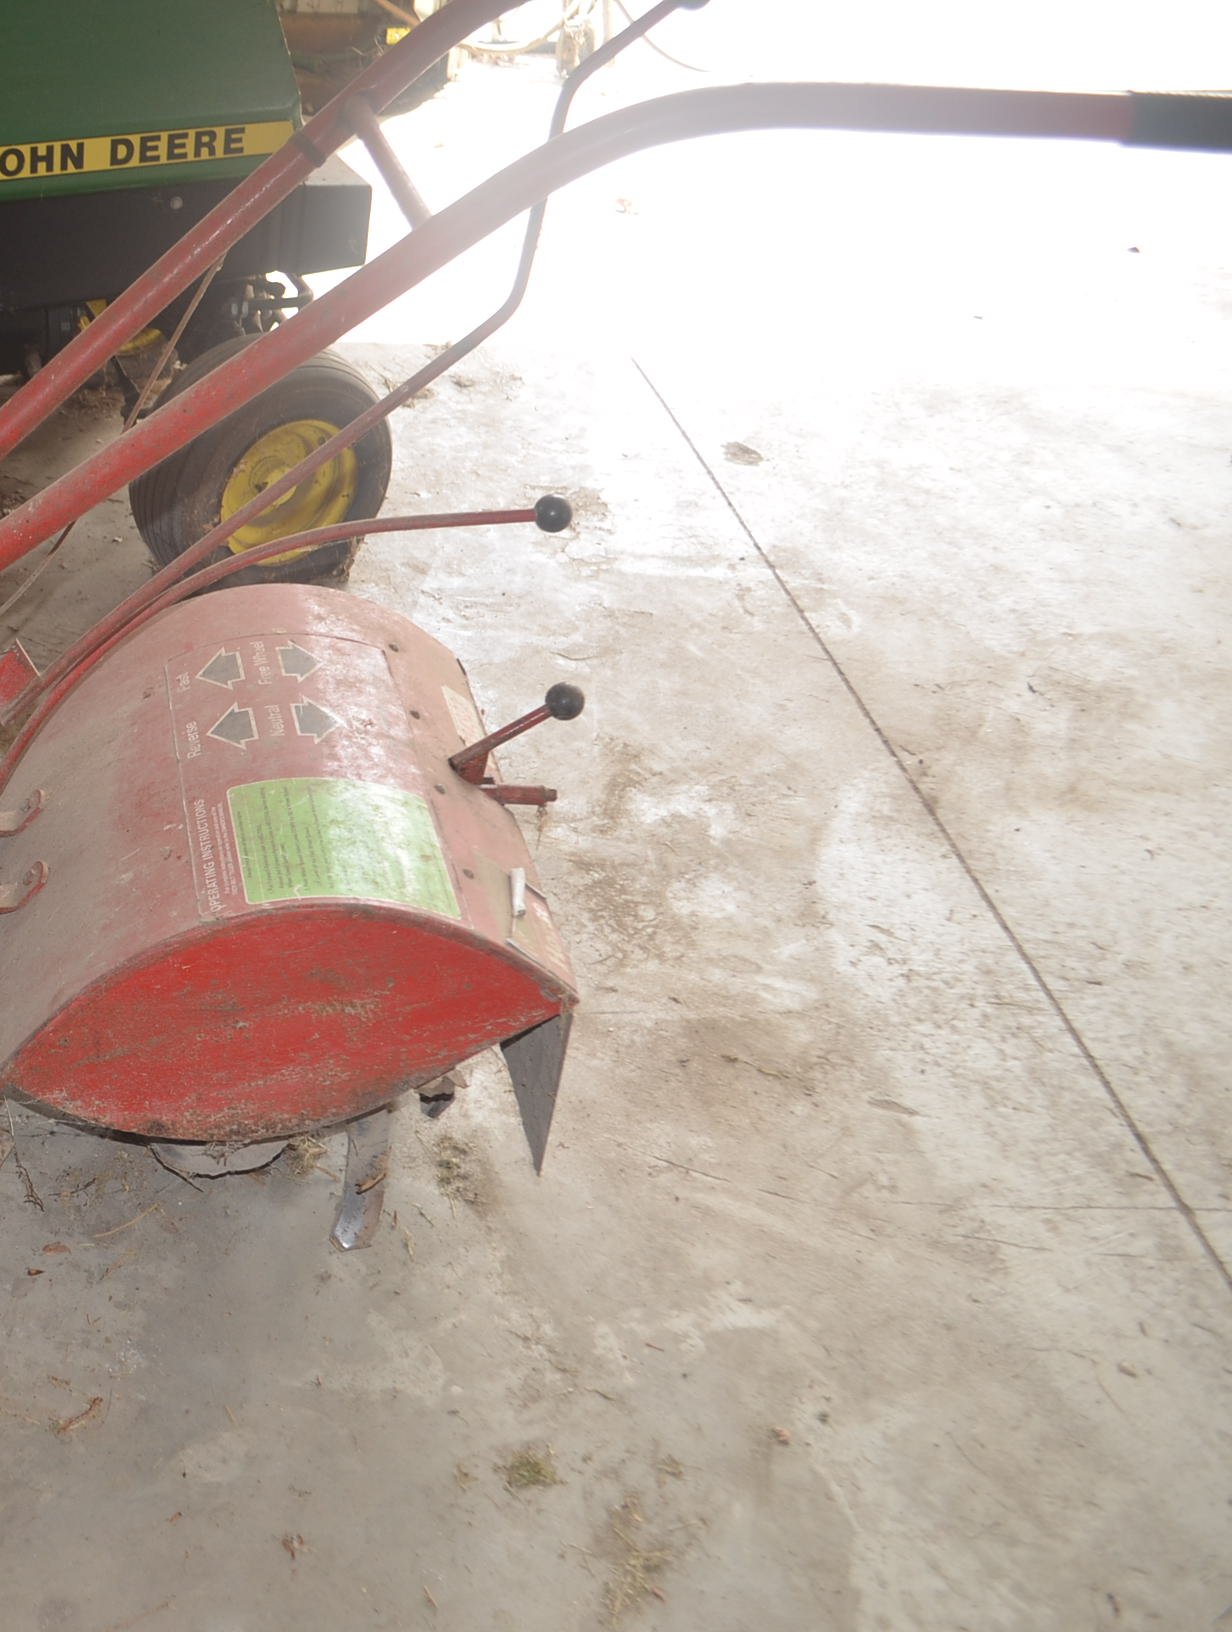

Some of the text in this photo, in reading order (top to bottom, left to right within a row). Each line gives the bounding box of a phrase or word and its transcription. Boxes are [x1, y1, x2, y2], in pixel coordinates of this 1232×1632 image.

[109, 127, 246, 167] DEERE
[249, 641, 272, 685] Free Wheel
[186, 720, 201, 758] Reverse
[264, 704, 285, 737] Neutral
[194, 799, 214, 860] INSTRUCTIONS
[203, 860, 226, 913] OPERATING
